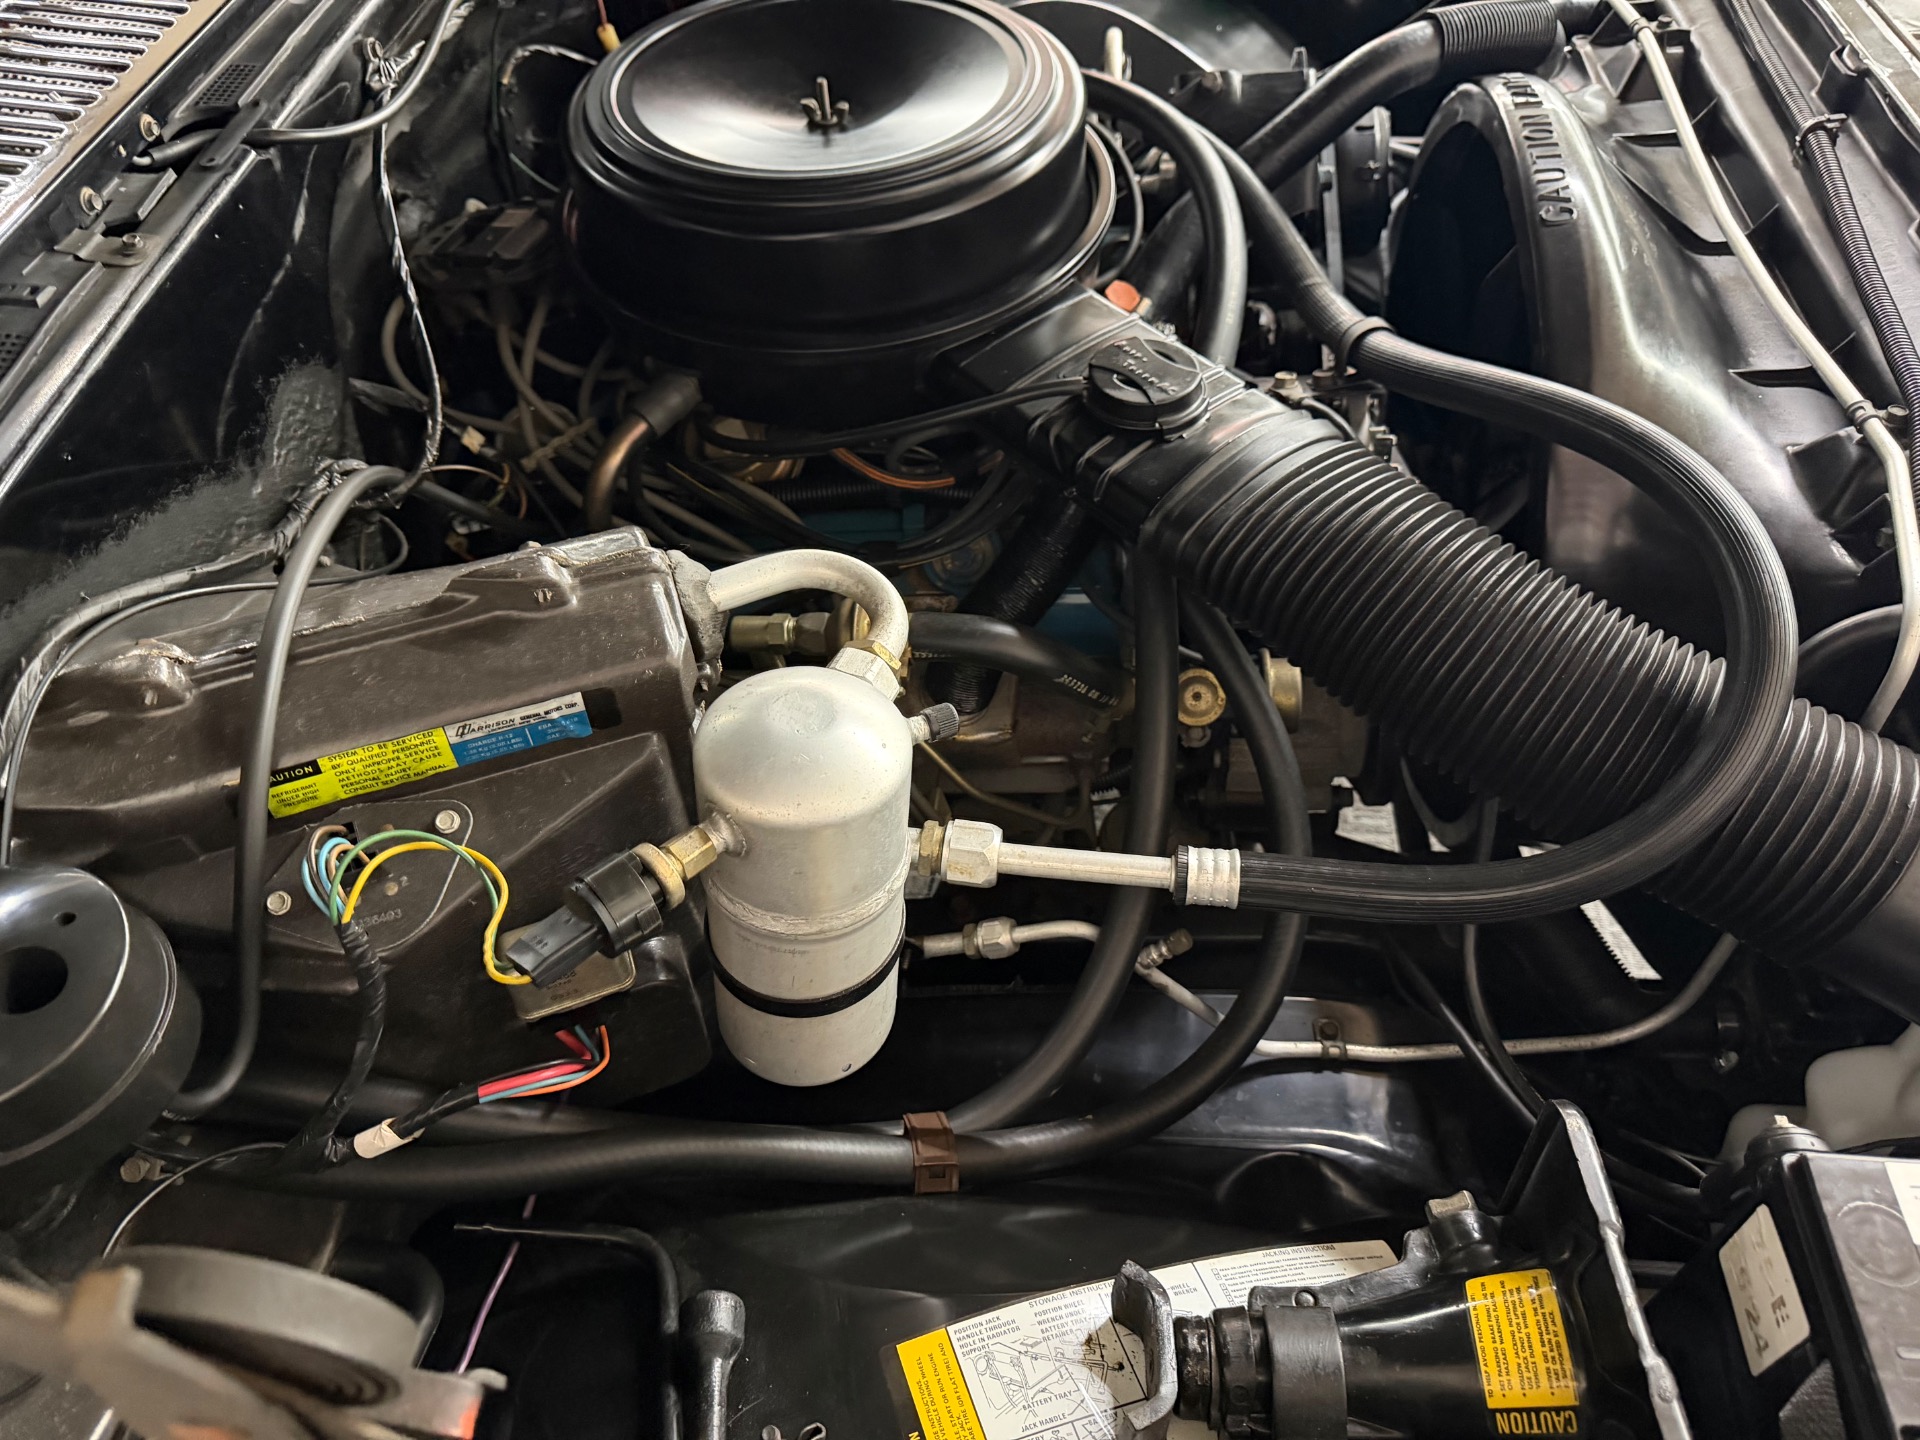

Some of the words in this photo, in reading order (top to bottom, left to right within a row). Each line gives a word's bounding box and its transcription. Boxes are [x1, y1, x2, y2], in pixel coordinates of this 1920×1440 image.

[1519, 114, 1577, 227] CAUTION
[565, 702, 580, 710] CORP.
[328, 749, 358, 763] SYSTEM
[362, 745, 374, 754] TO
[378, 742, 389, 750] BE
[391, 731, 434, 747] SERVICED
[331, 762, 342, 770] BY
[346, 751, 387, 766] QUALIFIED
[391, 738, 437, 755] PERSONNEL
[362, 755, 401, 769] IMPROPER
[404, 745, 439, 759] SERVICE
[269, 765, 314, 783] AUTION
[338, 768, 383, 783] METHODS
[388, 761, 407, 770] MAY
[412, 751, 443, 764] CAUSE
[271, 782, 317, 799] REFRIGERANT
[341, 776, 381, 789] PERSONAL
[344, 782, 380, 795] CONSULT
[382, 774, 412, 786] SERVICE
[276, 792, 301, 804] UNDER
[302, 788, 320, 797] HIGH
[283, 796, 319, 808] PRESSURE
[1262, 1248, 1290, 1258] JACKING
[1291, 1244, 1336, 1254] INSTRUCTIONS
[1170, 1282, 1190, 1291] WHEEL
[1173, 1287, 1198, 1297] WRENCH
[1028, 1291, 1068, 1308] STOWAGE
[1034, 1305, 1063, 1318] POSITION
[1063, 1299, 1085, 1310] WHEEL
[1502, 1290, 1514, 1328] INSTRUCTIONS
[1537, 1293, 1545, 1310] WHILE
[1036, 1315, 1064, 1326] WRENCH
[1064, 1309, 1086, 1319] UNDER
[1485, 1304, 1493, 1322] FIRMLY
[1510, 1300, 1520, 1320] LIFTING
[1520, 1310, 1528, 1330] WHEEL
[953, 1321, 984, 1335] POSITION
[984, 1315, 1002, 1326] JACK
[956, 1330, 983, 1343] HANDLE
[983, 1319, 1016, 1333] THROUGH
[1040, 1322, 1069, 1335] BATTERY
[1070, 1317, 1087, 1327] TRAY
[1474, 1311, 1484, 1344] PERSONAL
[1494, 1314, 1504, 1345] WARNING
[1541, 1311, 1550, 1336] ENGINE
[1552, 1329, 1559, 1338] BY
[958, 1340, 978, 1350] HOLE
[986, 1325, 1021, 1340] RADIATOR
[1042, 1329, 1076, 1343] RETAINER
[1488, 1324, 1497, 1344] BRAKE
[1535, 1320, 1546, 1348] BENEATH
[938, 1342, 947, 1356] AND
[961, 1343, 991, 1358] SUPPORT
[1510, 1330, 1520, 1360] JACKING
[1525, 1332, 1535, 1359] DURING
[928, 1352, 939, 1377] ENGINE
[1480, 1345, 1488, 1368] AVOID
[1493, 1346, 1503, 1377] PARKING
[1500, 1347, 1510, 1376] HAZARD
[1522, 1355, 1530, 1374] JACK
[1550, 1355, 1557, 1365] OR
[1555, 1340, 1568, 1379] SUPPORTED
[916, 1356, 927, 1380] WHEEL
[1516, 1362, 1526, 1390] FOLLOW
[1531, 1361, 1541, 1389] VEHICLE
[923, 1380, 936, 1406] DURING
[936, 1378, 945, 1392] RUN
[949, 1377, 960, 1394] FLAT
[1488, 1389, 1494, 1398] TO
[1498, 1379, 1506, 1391] SET
[1506, 1379, 1513, 1390] ON
[916, 1379, 936, 1429] INSTRUCTIONS.
[942, 1393, 949, 1404] OR
[1022, 1396, 1054, 1411] BATTERY
[1054, 1390, 1072, 1402] TRAY
[933, 1408, 946, 1438] VEHICLE
[946, 1406, 957, 1428] START
[961, 1408, 970, 1425] TIRE
[1021, 1422, 1038, 1433] JACK
[1039, 1412, 1068, 1426] HANDLE
[1495, 1410, 1578, 1434] CAUTION
[967, 1426, 976, 1440] ARE
